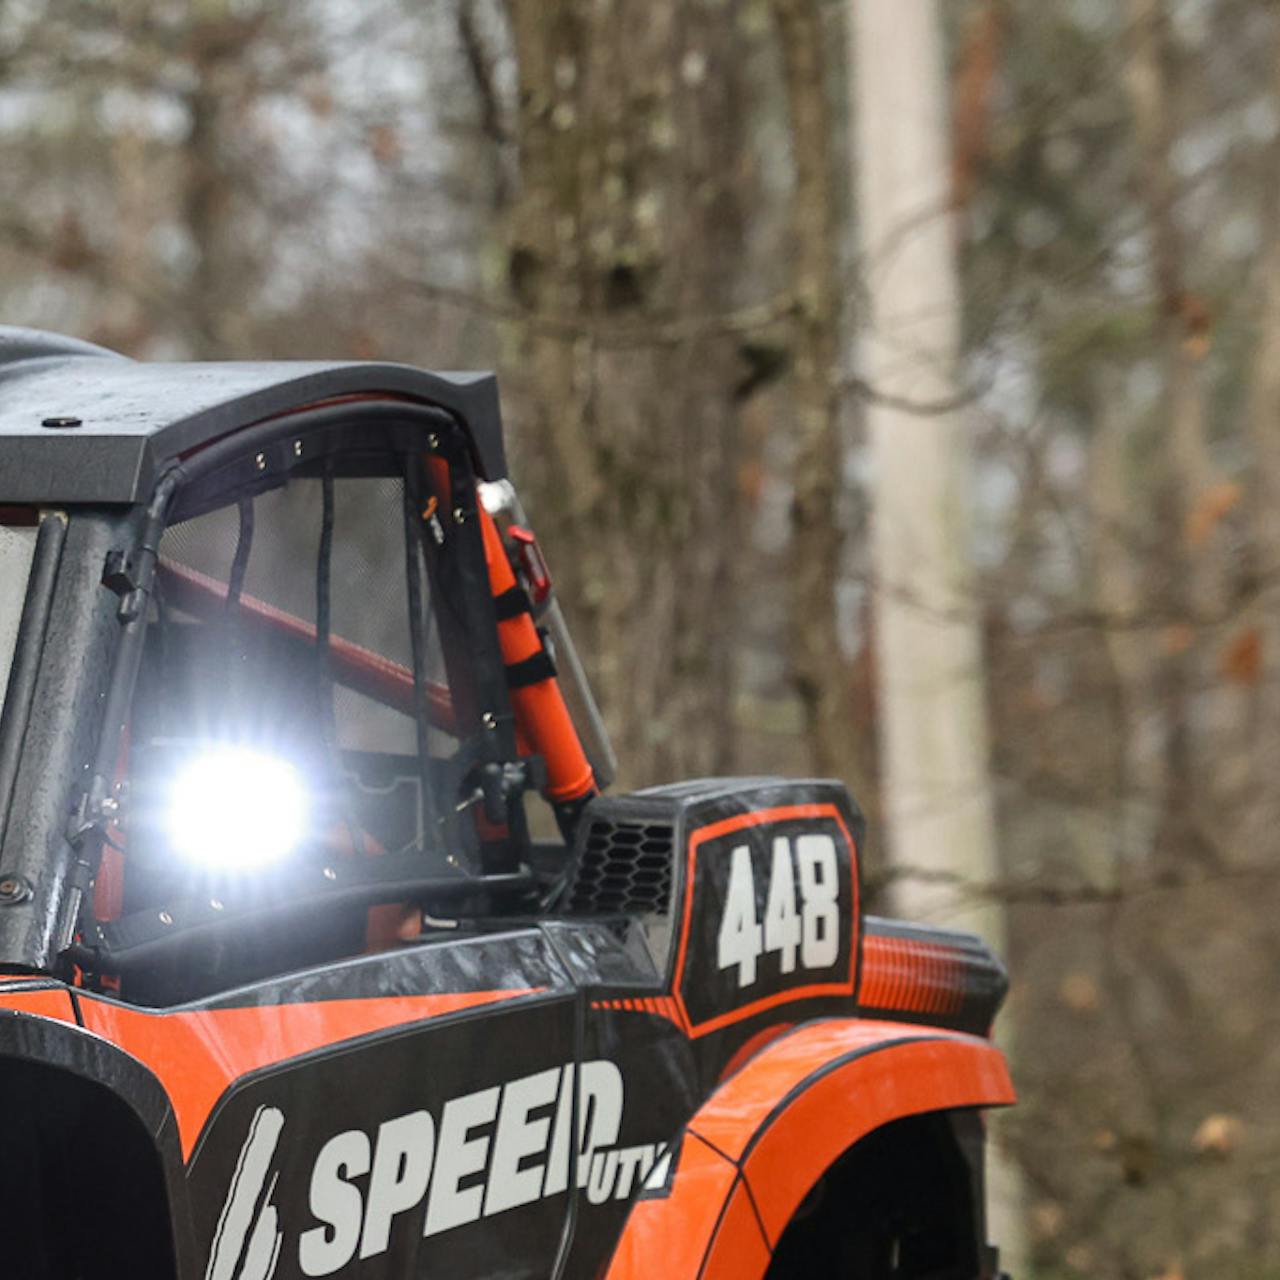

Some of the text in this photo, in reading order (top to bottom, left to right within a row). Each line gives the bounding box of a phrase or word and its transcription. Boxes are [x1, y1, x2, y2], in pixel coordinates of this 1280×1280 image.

[716, 834, 840, 988] 448
[298, 1059, 672, 1278] SPEED UTV
